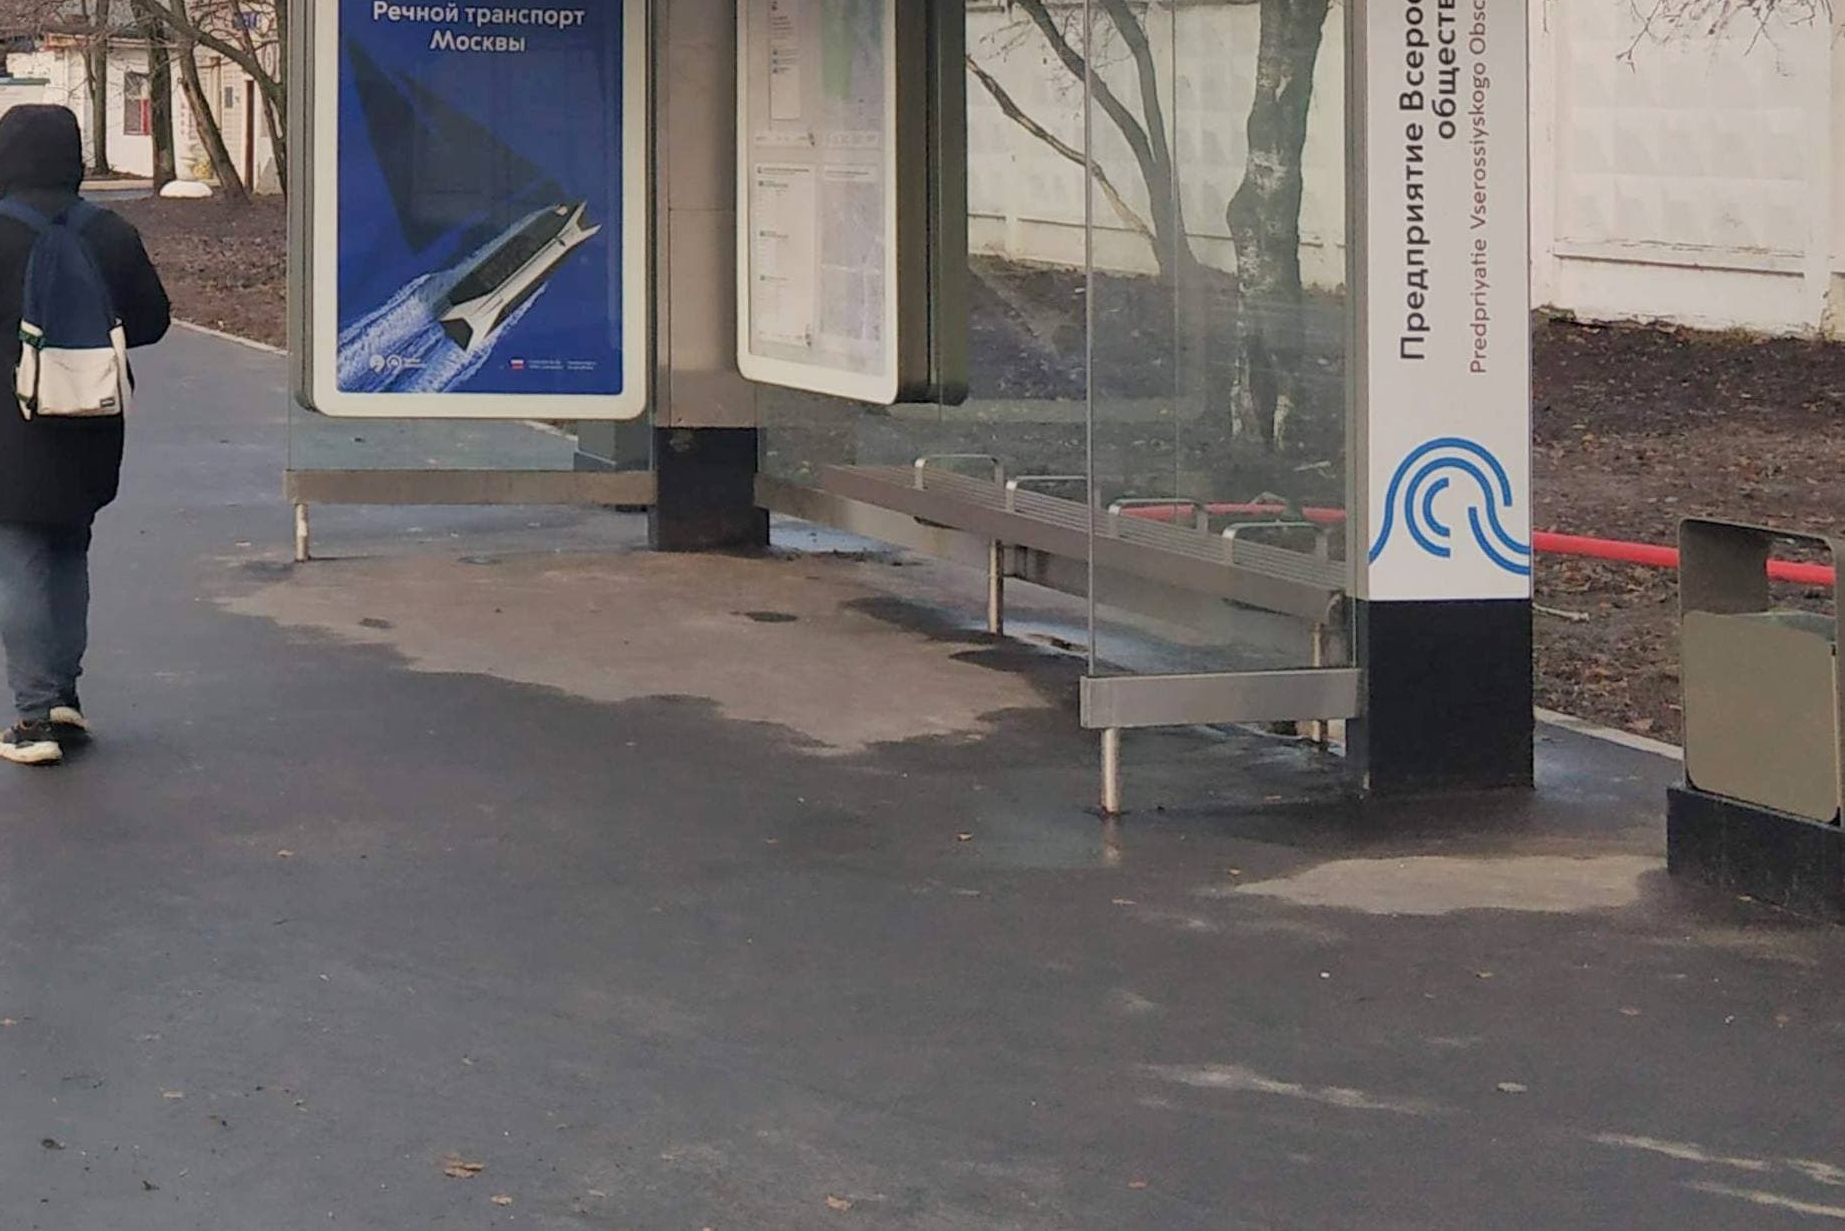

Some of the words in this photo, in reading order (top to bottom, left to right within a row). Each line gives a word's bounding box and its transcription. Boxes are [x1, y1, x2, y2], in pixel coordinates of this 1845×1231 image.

[372, 0, 459, 23] Речной
[464, 7, 586, 29] транспорт
[429, 29, 526, 52] Москвы
[1468, 62, 1490, 230] Vserossiyskogo
[1400, 123, 1431, 360] Предприятие
[1469, 238, 1490, 373] Predpriyatie
